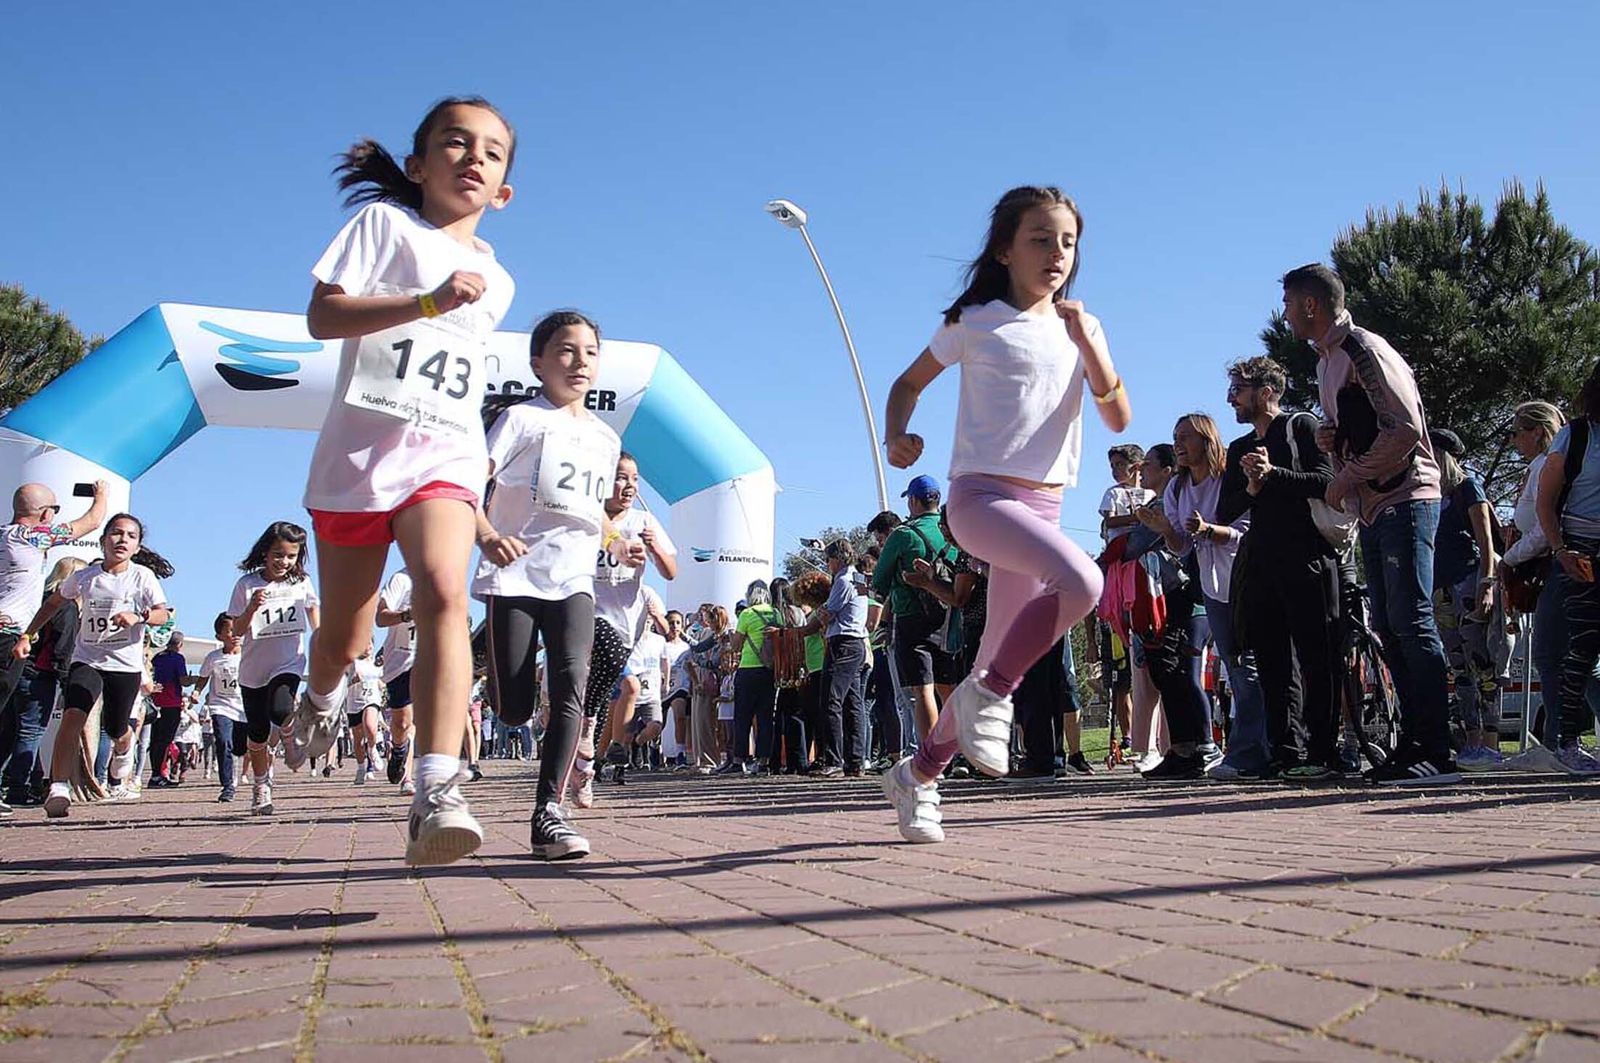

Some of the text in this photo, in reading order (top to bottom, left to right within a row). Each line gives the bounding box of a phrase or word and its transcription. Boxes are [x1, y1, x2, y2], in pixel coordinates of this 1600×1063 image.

[391, 338, 472, 400] 143
[360, 392, 398, 409] Huelva
[556, 461, 605, 504] 210
[72, 538, 99, 549] COPPE
[596, 549, 619, 568] 20
[718, 555, 752, 564] ATLANTIC
[261, 606, 297, 625] 112
